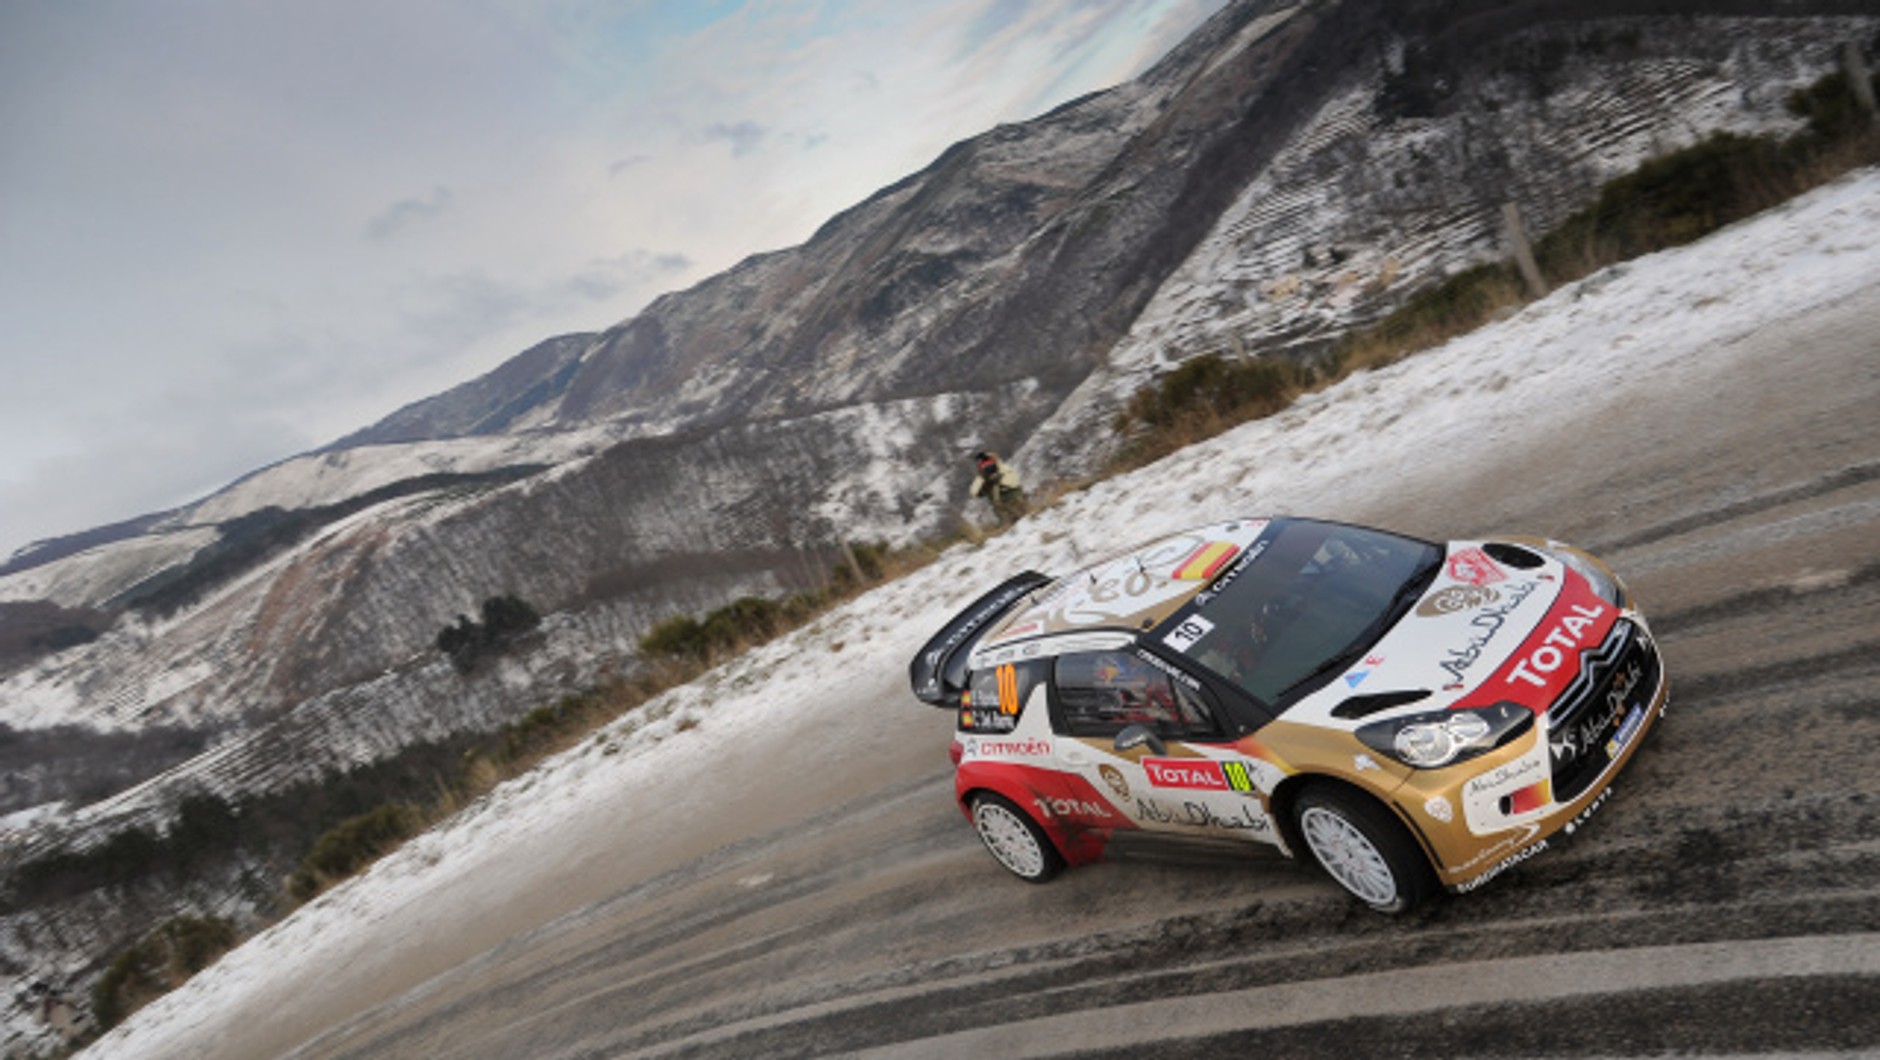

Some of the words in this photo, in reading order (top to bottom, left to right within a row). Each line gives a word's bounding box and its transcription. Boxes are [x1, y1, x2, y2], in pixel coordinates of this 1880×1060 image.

[1175, 622, 1203, 642] 10
[1506, 605, 1604, 687] TOTAL
[996, 663, 1018, 715] 10
[1147, 764, 1223, 786] TOTAL
[1224, 762, 1252, 792] 10
[1033, 797, 1112, 818] TOTAL
